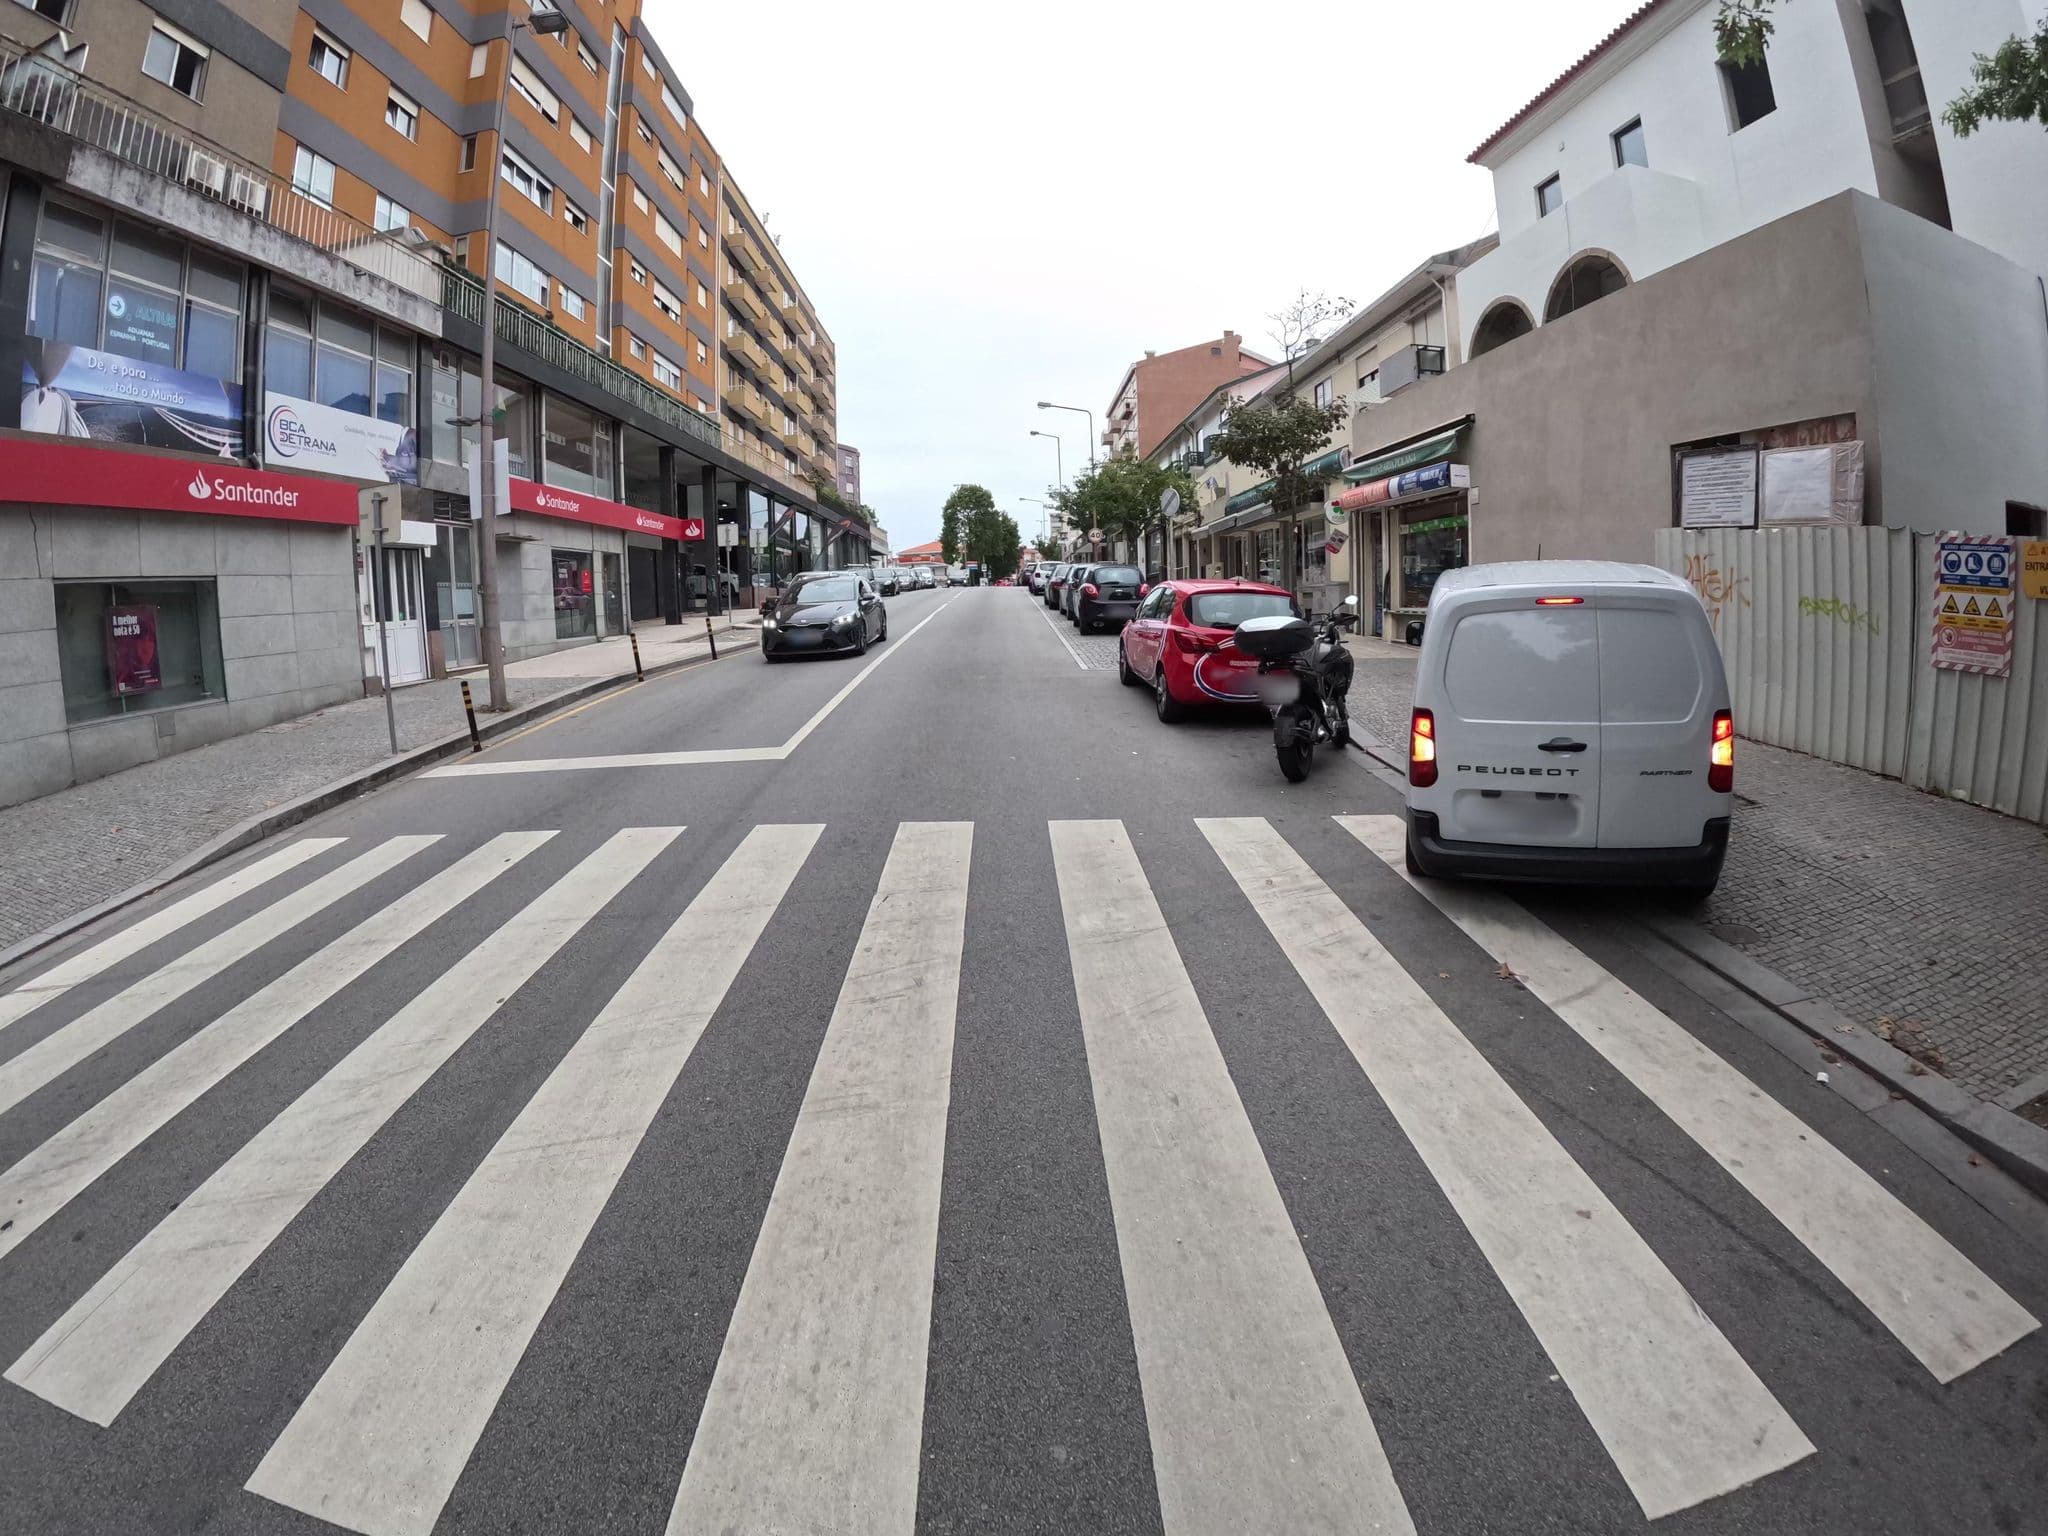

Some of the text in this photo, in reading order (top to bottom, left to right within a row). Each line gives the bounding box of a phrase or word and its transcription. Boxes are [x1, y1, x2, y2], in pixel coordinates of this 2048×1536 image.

[111, 365, 119, 374] e
[121, 366, 147, 379] para
[115, 382, 139, 396] todo
[142, 387, 149, 398] o
[151, 387, 185, 405] Mundo
[279, 418, 306, 434] BCA
[279, 431, 337, 453] DETRANA
[214, 478, 299, 507] Santander
[546, 494, 580, 513] Santander
[642, 517, 665, 530] Santander
[117, 615, 138, 625] melhor
[1457, 765, 1580, 777] PEUGEOT
